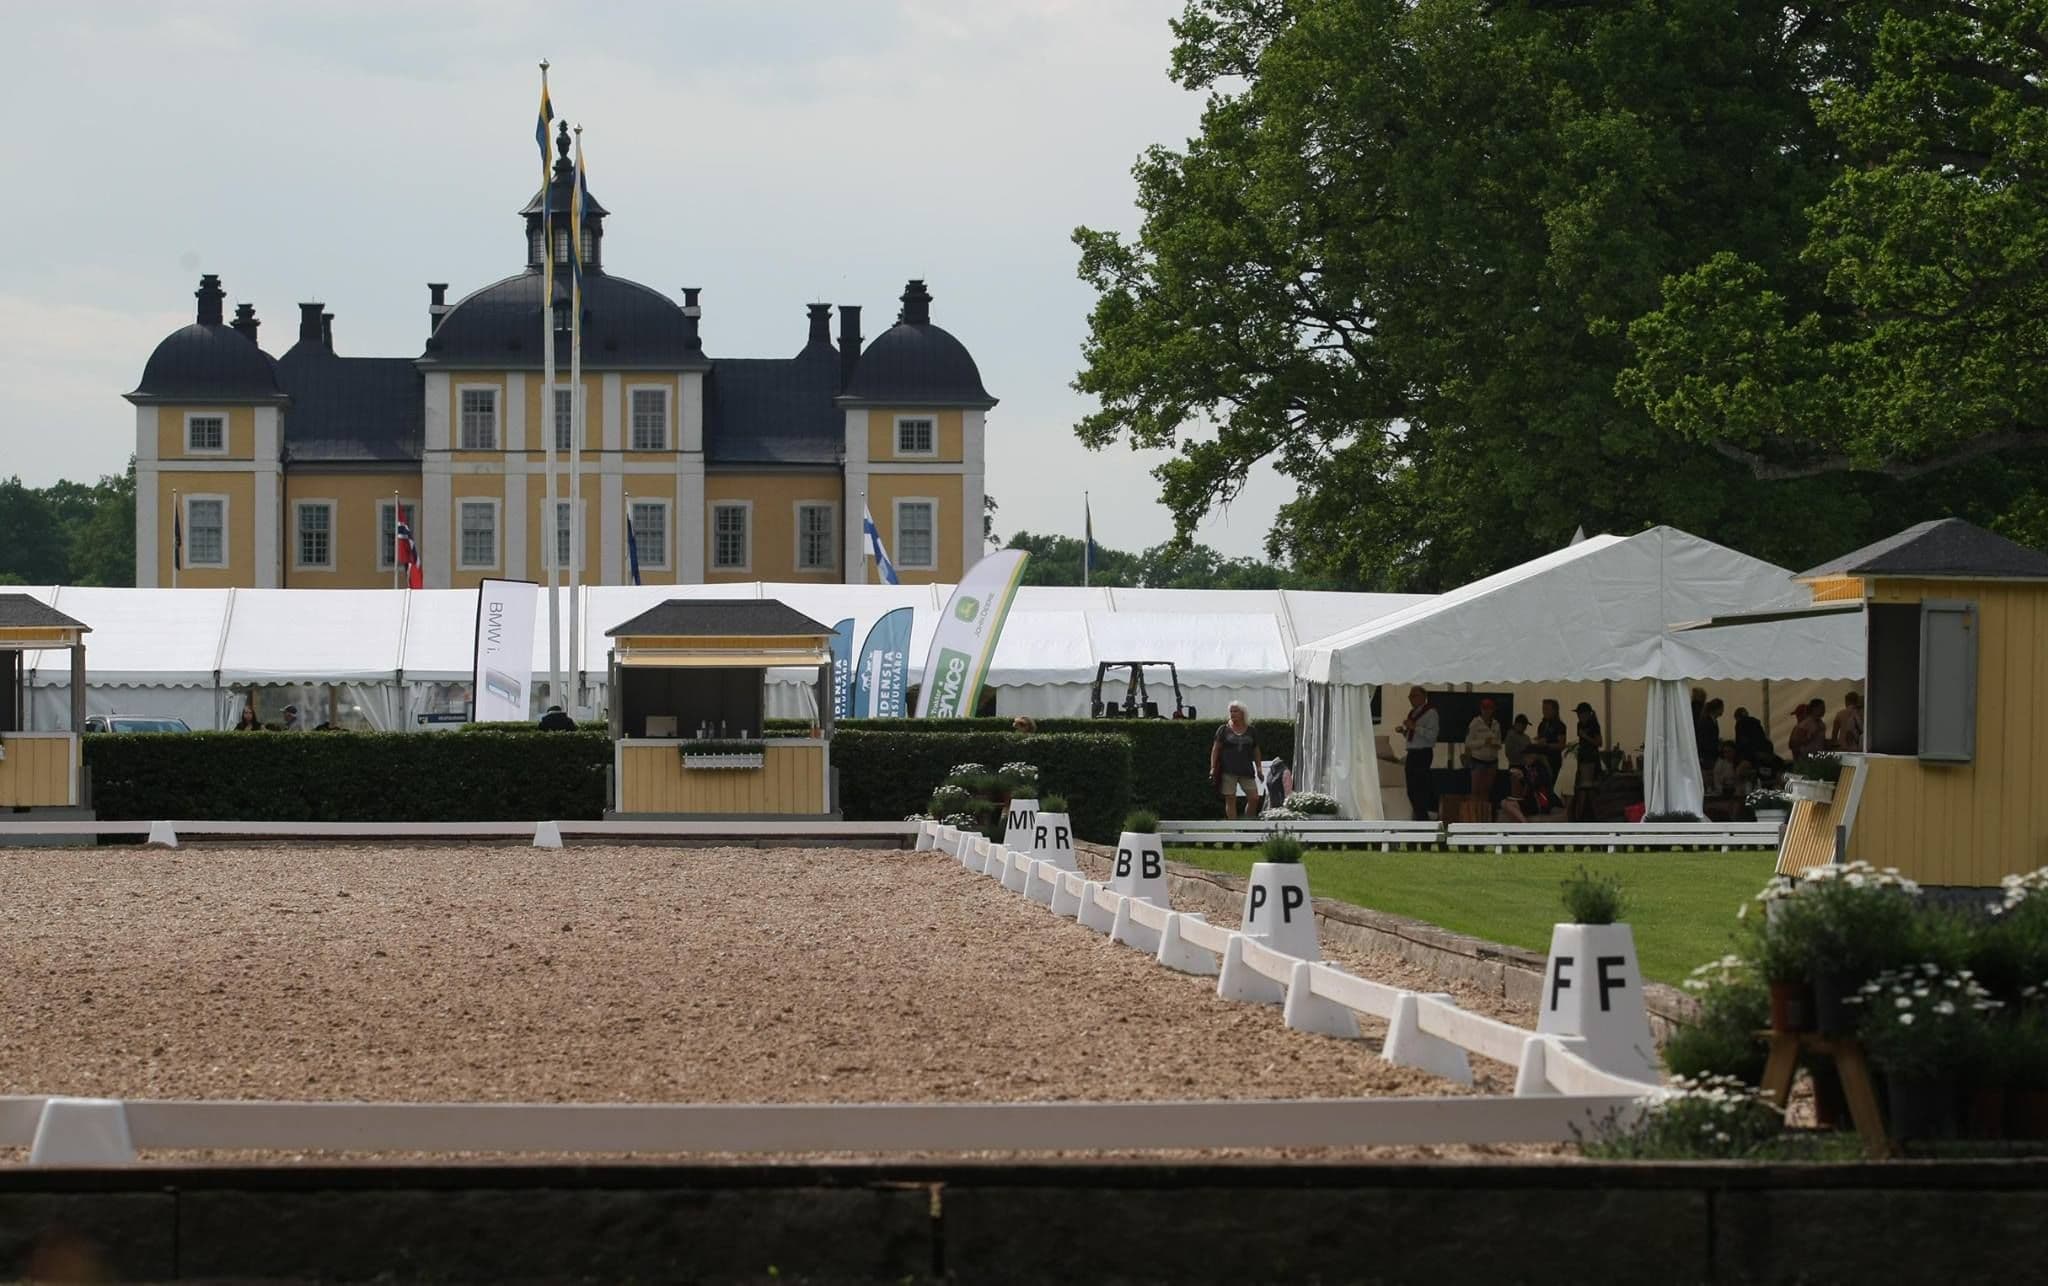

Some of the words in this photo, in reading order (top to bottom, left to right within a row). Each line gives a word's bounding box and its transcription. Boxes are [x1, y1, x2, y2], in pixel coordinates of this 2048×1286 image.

[487, 602, 503, 644] BMW
[1035, 826, 1047, 849] R
[1055, 826, 1070, 849] R
[1116, 849, 1133, 877] B
[1142, 850, 1162, 879] B
[1249, 885, 1267, 923] P
[1281, 886, 1304, 923] P
[1550, 956, 1574, 1011] F
[1597, 956, 1626, 1011] F
